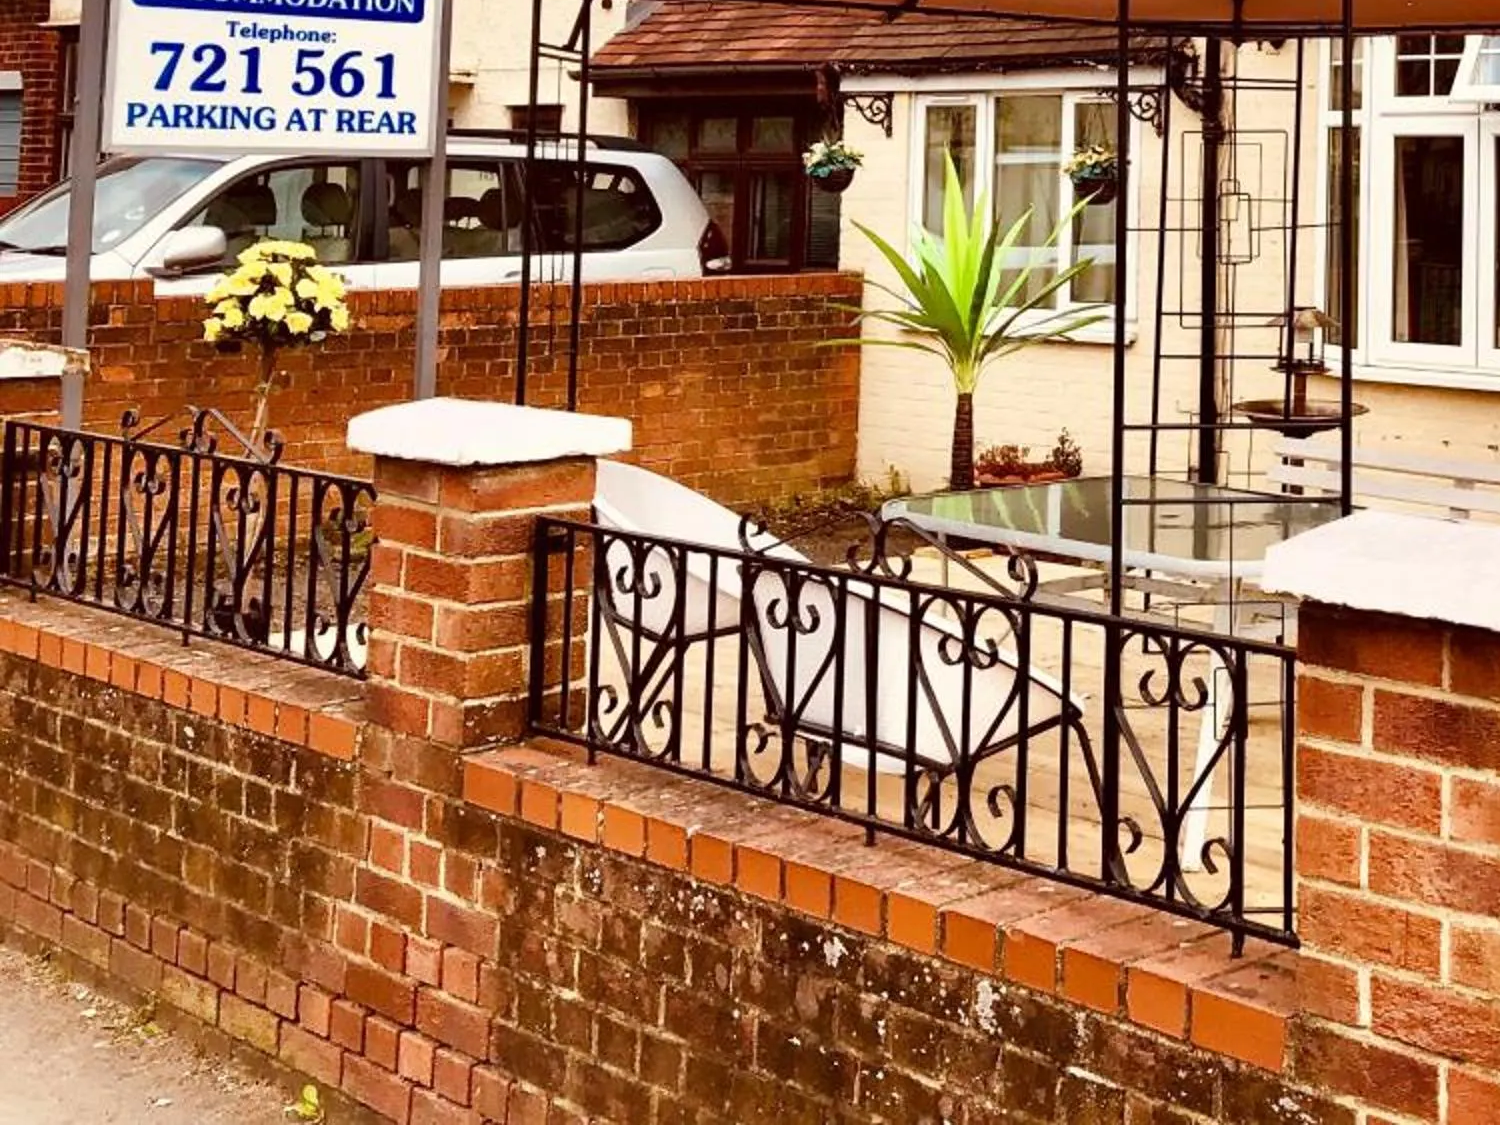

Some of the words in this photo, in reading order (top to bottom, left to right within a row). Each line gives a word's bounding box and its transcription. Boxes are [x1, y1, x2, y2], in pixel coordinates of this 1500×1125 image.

[226, 20, 337, 44] Telephone:
[150, 42, 263, 94] 721
[291, 48, 397, 99] 561
[125, 102, 277, 131] PARKING
[285, 108, 328, 133] AT
[335, 109, 417, 135] REAR
